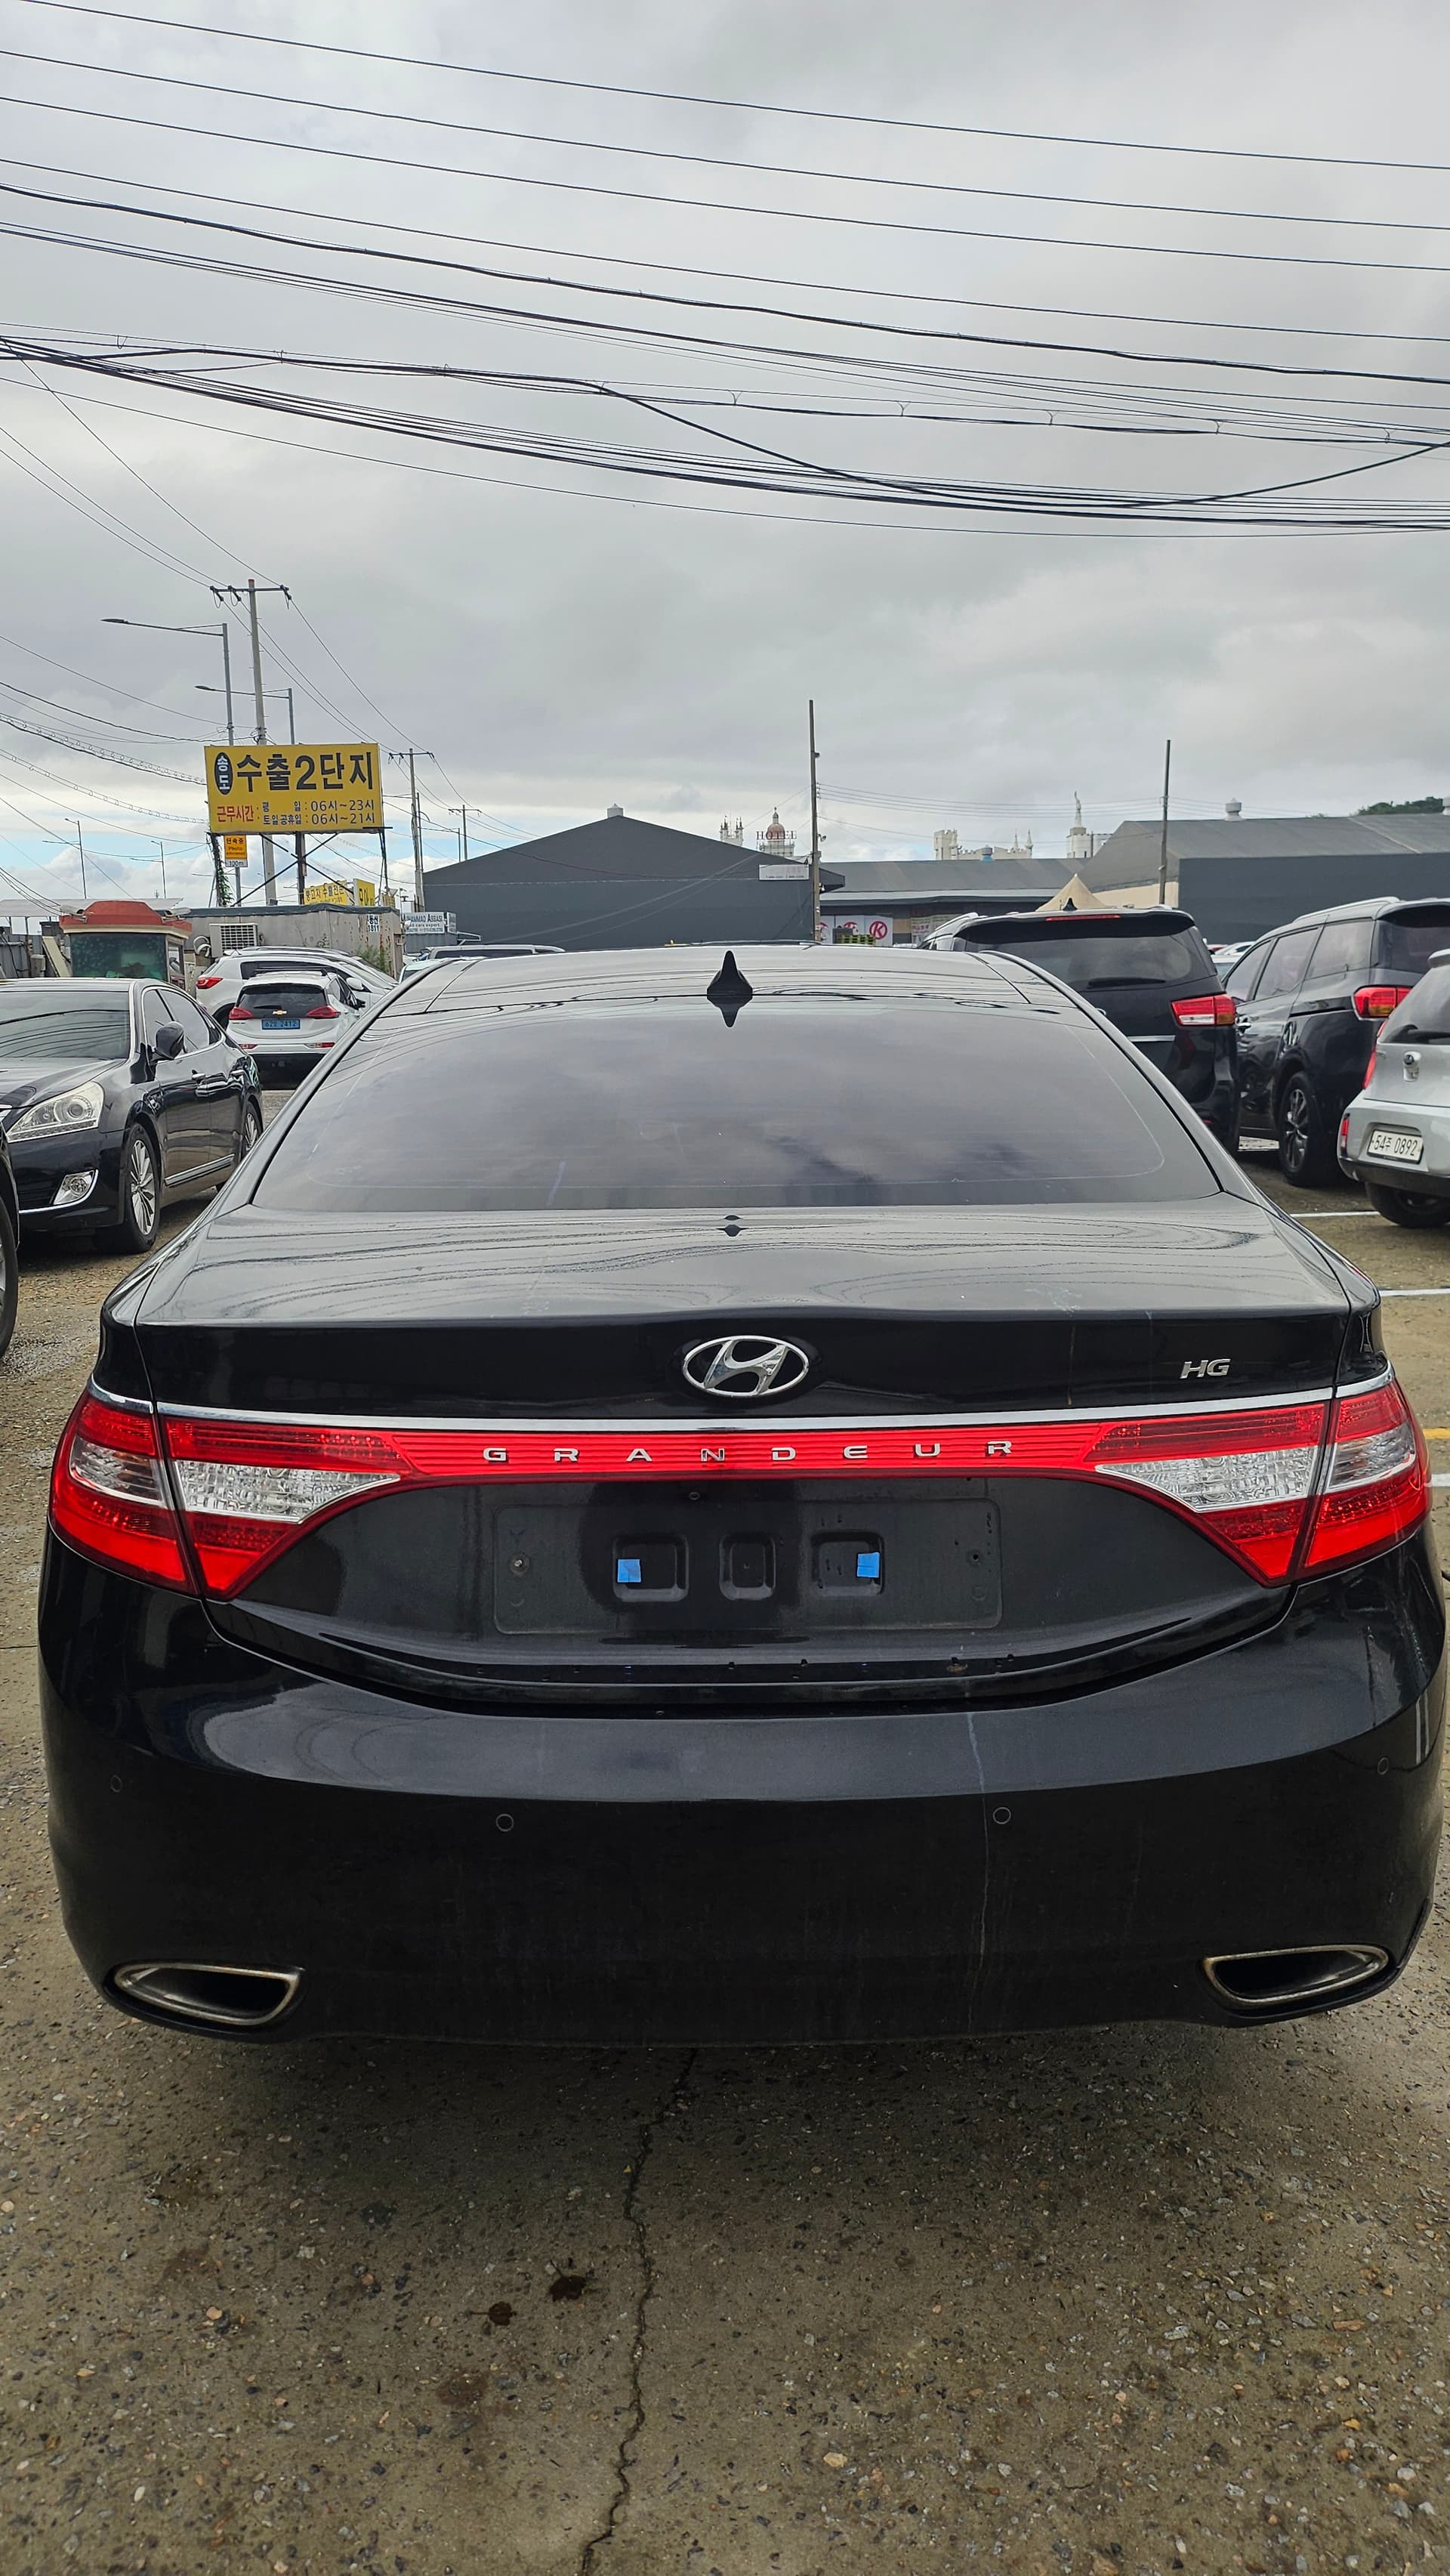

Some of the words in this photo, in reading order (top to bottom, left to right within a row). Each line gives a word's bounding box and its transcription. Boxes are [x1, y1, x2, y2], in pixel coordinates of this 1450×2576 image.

[217, 755, 230, 790] 송도
[236, 752, 373, 792] 수출2단지
[217, 805, 255, 823] 근무시간
[756, 830, 797, 840] HOTEL
[1393, 1137, 1418, 1157] 0892
[1179, 1358, 1231, 1379] HG
[482, 1439, 1013, 1463] GRANDEUR
